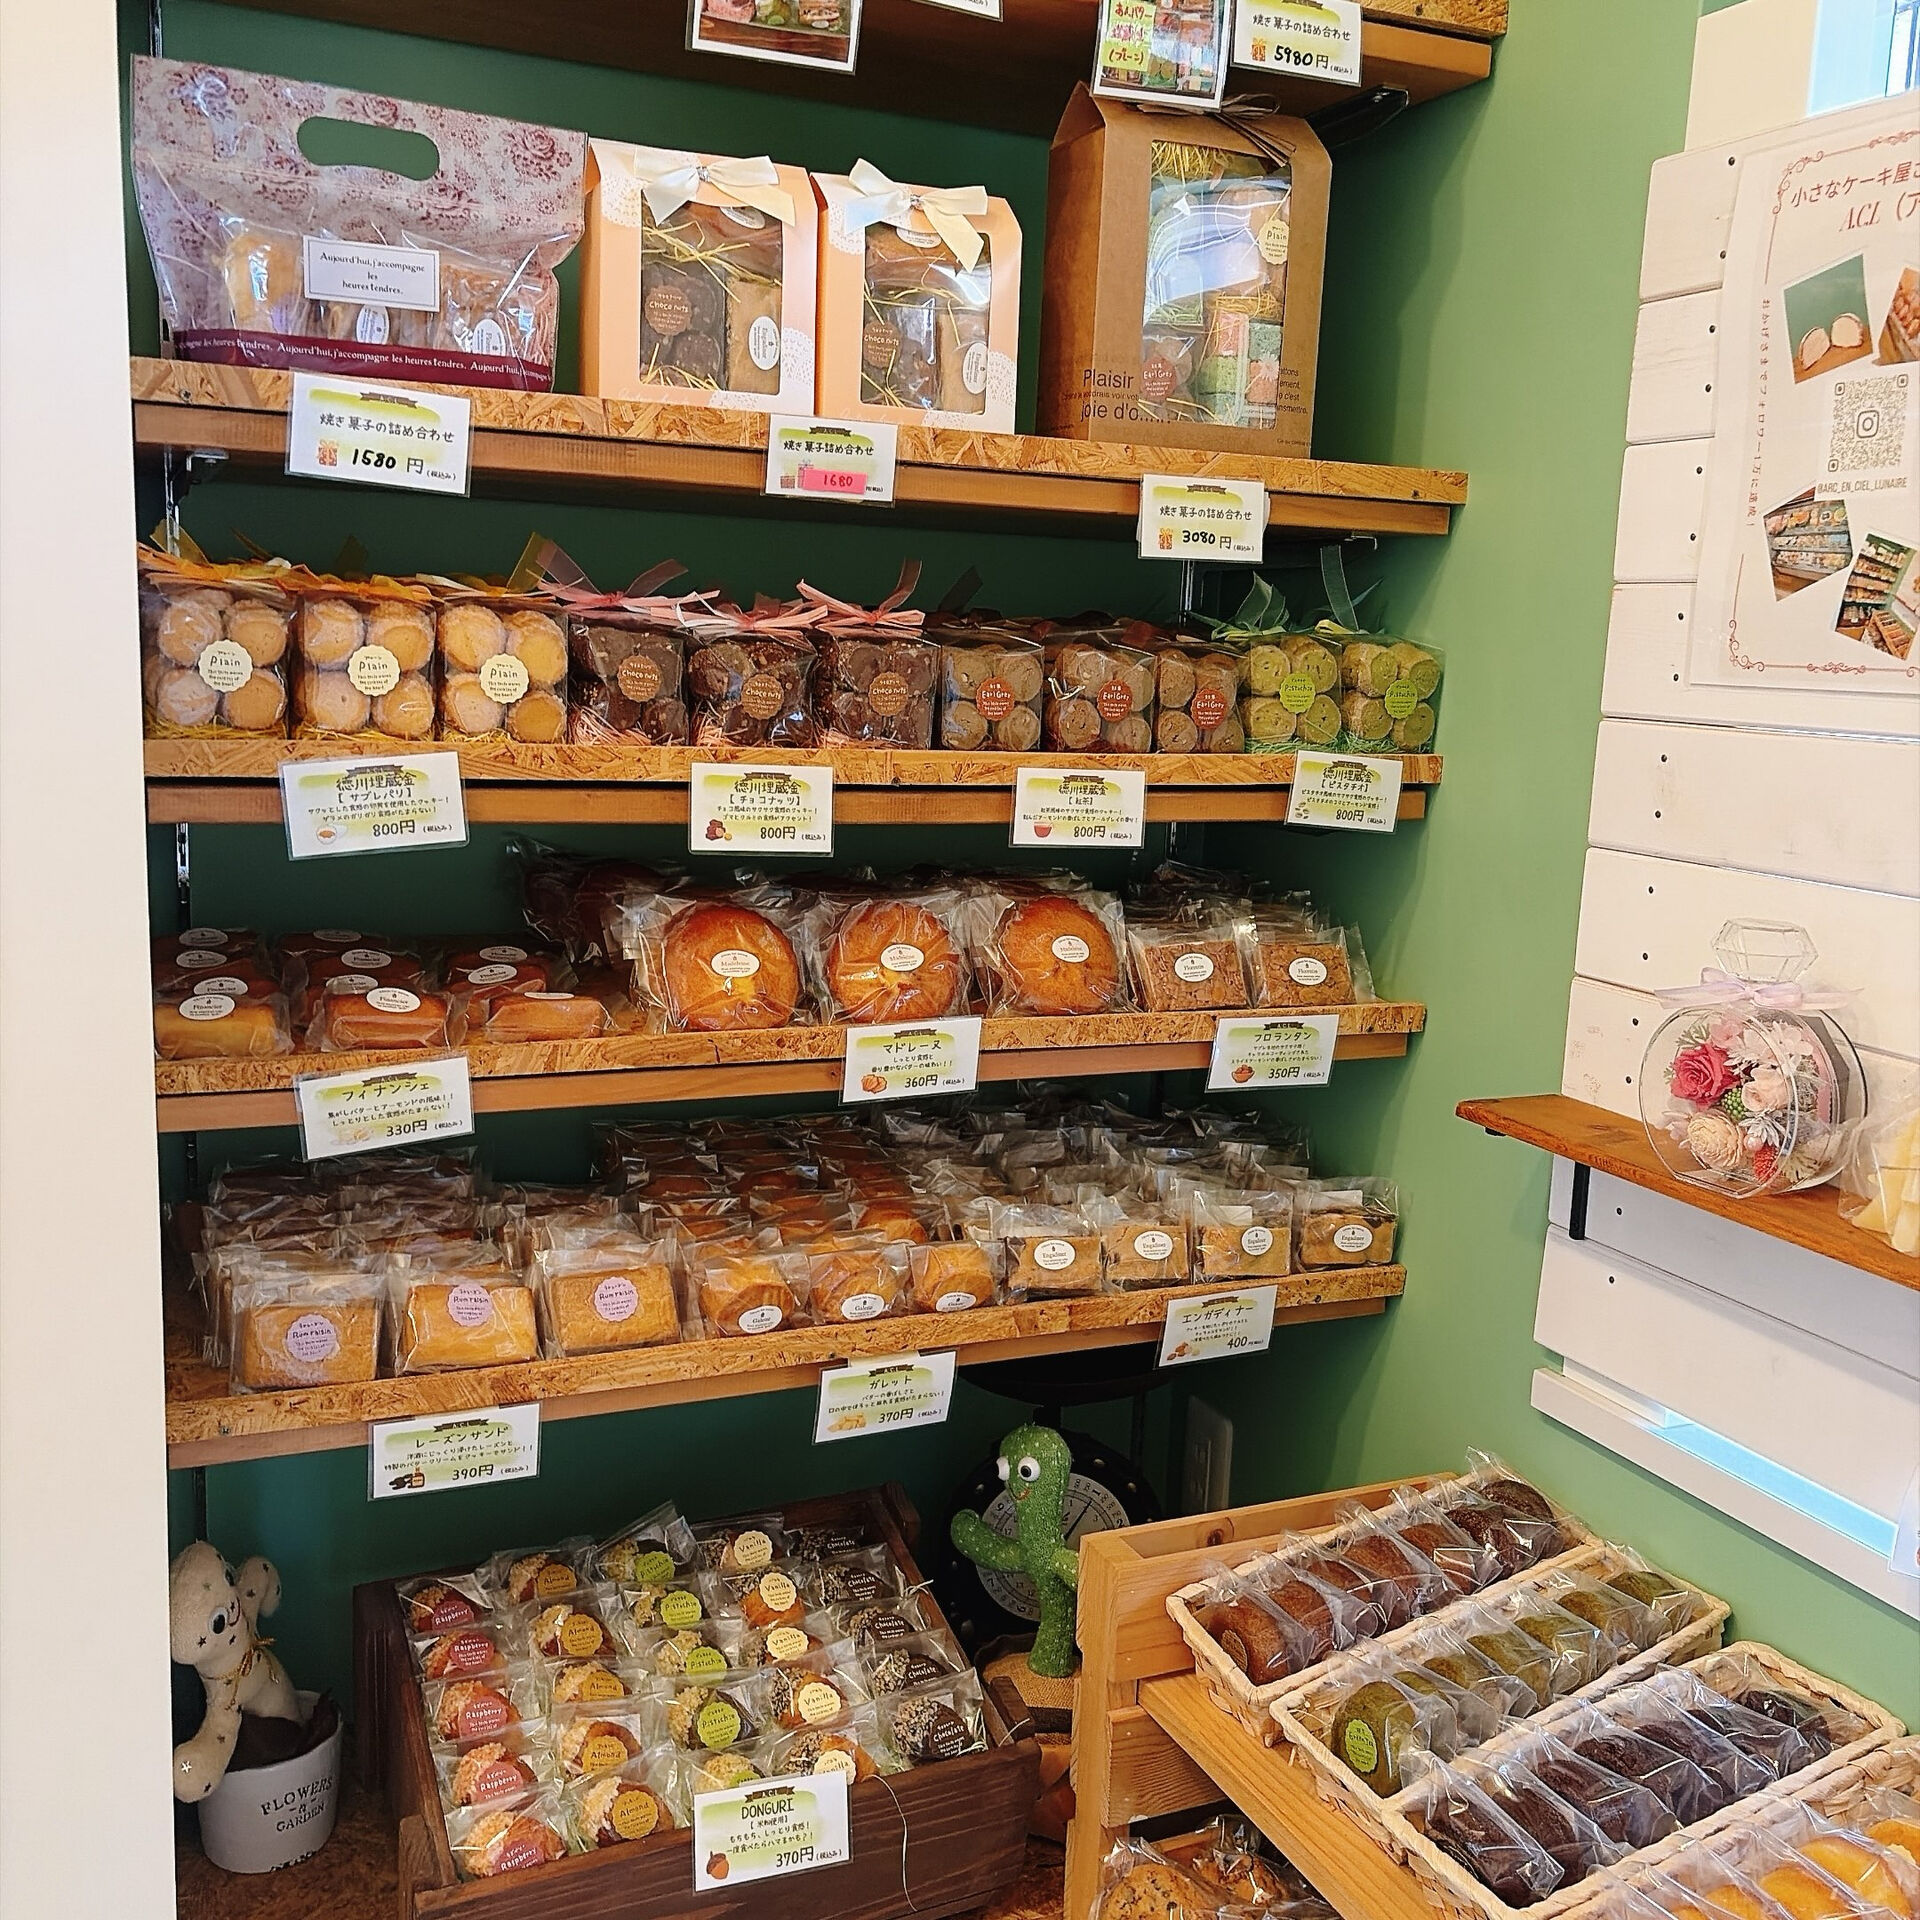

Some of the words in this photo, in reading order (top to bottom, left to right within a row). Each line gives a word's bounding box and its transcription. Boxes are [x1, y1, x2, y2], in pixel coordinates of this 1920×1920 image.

[1252, 14, 1351, 42] 焼き菓子の詰め合わせ
[1274, 45, 1313, 67] 5980
[1315, 54, 1329, 70] 円
[1266, 230, 1288, 241] Plain
[391, 353, 403, 364] les
[1083, 369, 1134, 389] Plaisir
[1080, 400, 1108, 423] joie
[320, 413, 455, 444] 焼き菓子の詰め合わせ
[783, 439, 875, 456] 焼き菓子詰め合わせ
[352, 448, 397, 470] 1580
[406, 457, 424, 474] 円
[823, 474, 854, 488] 1680
[1159, 505, 1253, 521] 焼き菓子の詰め合わせ
[1182, 529, 1216, 545] 3080
[1219, 536, 1232, 549] 円
[210, 655, 241, 667] Plain
[359, 661, 388, 672] Plain
[490, 668, 518, 679] Plain
[621, 669, 644, 680] Choco
[745, 689, 767, 698] Choco
[872, 687, 893, 696] Choco
[336, 772, 417, 791] 徳川埋蔵金
[1322, 767, 1375, 784] 徳川埋蔵金
[734, 780, 801, 795] 徳川埋蔵金
[1058, 783, 1109, 796] 徳川埋蔵金
[1336, 809, 1365, 822] 800円
[373, 819, 415, 837] 800円
[760, 826, 796, 840] 800円
[1073, 825, 1106, 838] 800円
[1254, 1032, 1312, 1043] フロランタン
[883, 1040, 942, 1054] マドレーヌ
[1268, 1066, 1301, 1079] 350円
[904, 1074, 938, 1088] 360円
[342, 1081, 430, 1102] フィナンシェ
[386, 1119, 428, 1138] 330円
[1182, 1304, 1254, 1324] エンガディナー
[1227, 1336, 1248, 1349] 400
[869, 1375, 912, 1390] ガレット
[878, 1408, 914, 1424] 370円
[415, 1425, 510, 1449] レーズンサンド
[452, 1464, 494, 1481] 390円
[738, 1537, 767, 1553] Vanilla
[764, 1580, 790, 1593] Vanilla
[568, 1626, 595, 1637] Almond
[772, 1633, 801, 1646] Vanilla
[589, 1682, 618, 1692] Almond
[804, 1690, 833, 1706] Vanilla
[465, 1707, 502, 1720] Raspberry
[933, 1725, 965, 1743] Chocolate
[590, 1750, 621, 1760] Almond
[480, 1774, 517, 1792] Raspberry
[260, 1776, 333, 1816] FLOWERS
[276, 1802, 325, 1832] GARDEN
[619, 1802, 650, 1817] Almond
[741, 1798, 795, 1820] DONGURI
[729, 1821, 810, 1844] もちもち、しっとり食感！
[500, 1847, 537, 1871] Raspberry
[775, 1845, 814, 1868] 370円
